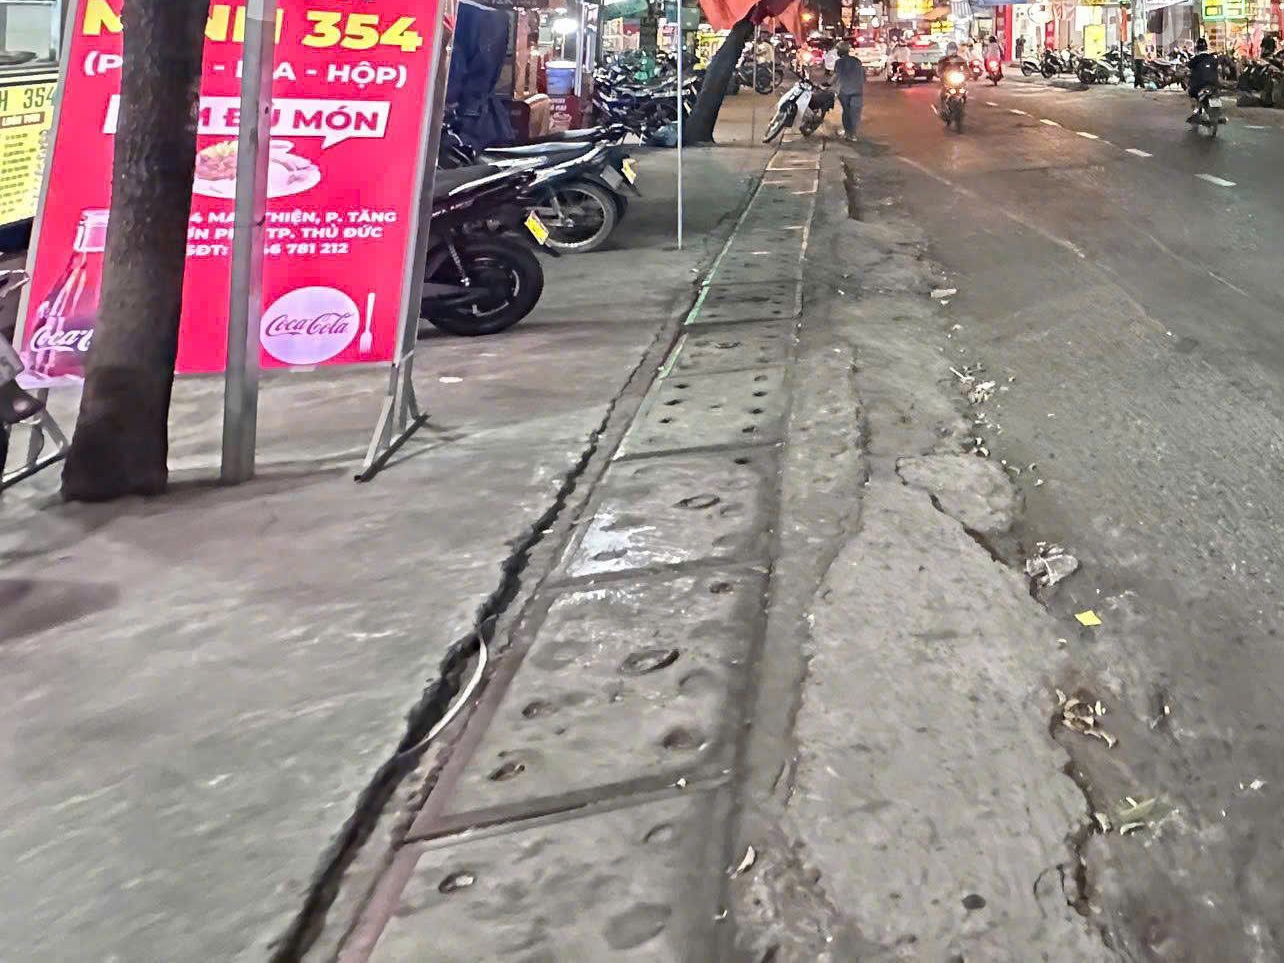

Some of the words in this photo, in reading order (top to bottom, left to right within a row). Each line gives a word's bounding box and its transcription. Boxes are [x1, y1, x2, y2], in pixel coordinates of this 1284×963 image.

[301, 10, 423, 52] 354
[327, 61, 408, 88] HỘP)
[293, 105, 379, 130] MÓN
[326, 212, 343, 223] P.
[349, 211, 397, 224] TĂNG
[266, 228, 296, 239] TP.
[302, 225, 339, 239] THỦ
[343, 225, 384, 238] ĐỨC
[287, 243, 316, 254] 781
[320, 243, 349, 254] 212
[265, 312, 354, 337] Coca-Cola
